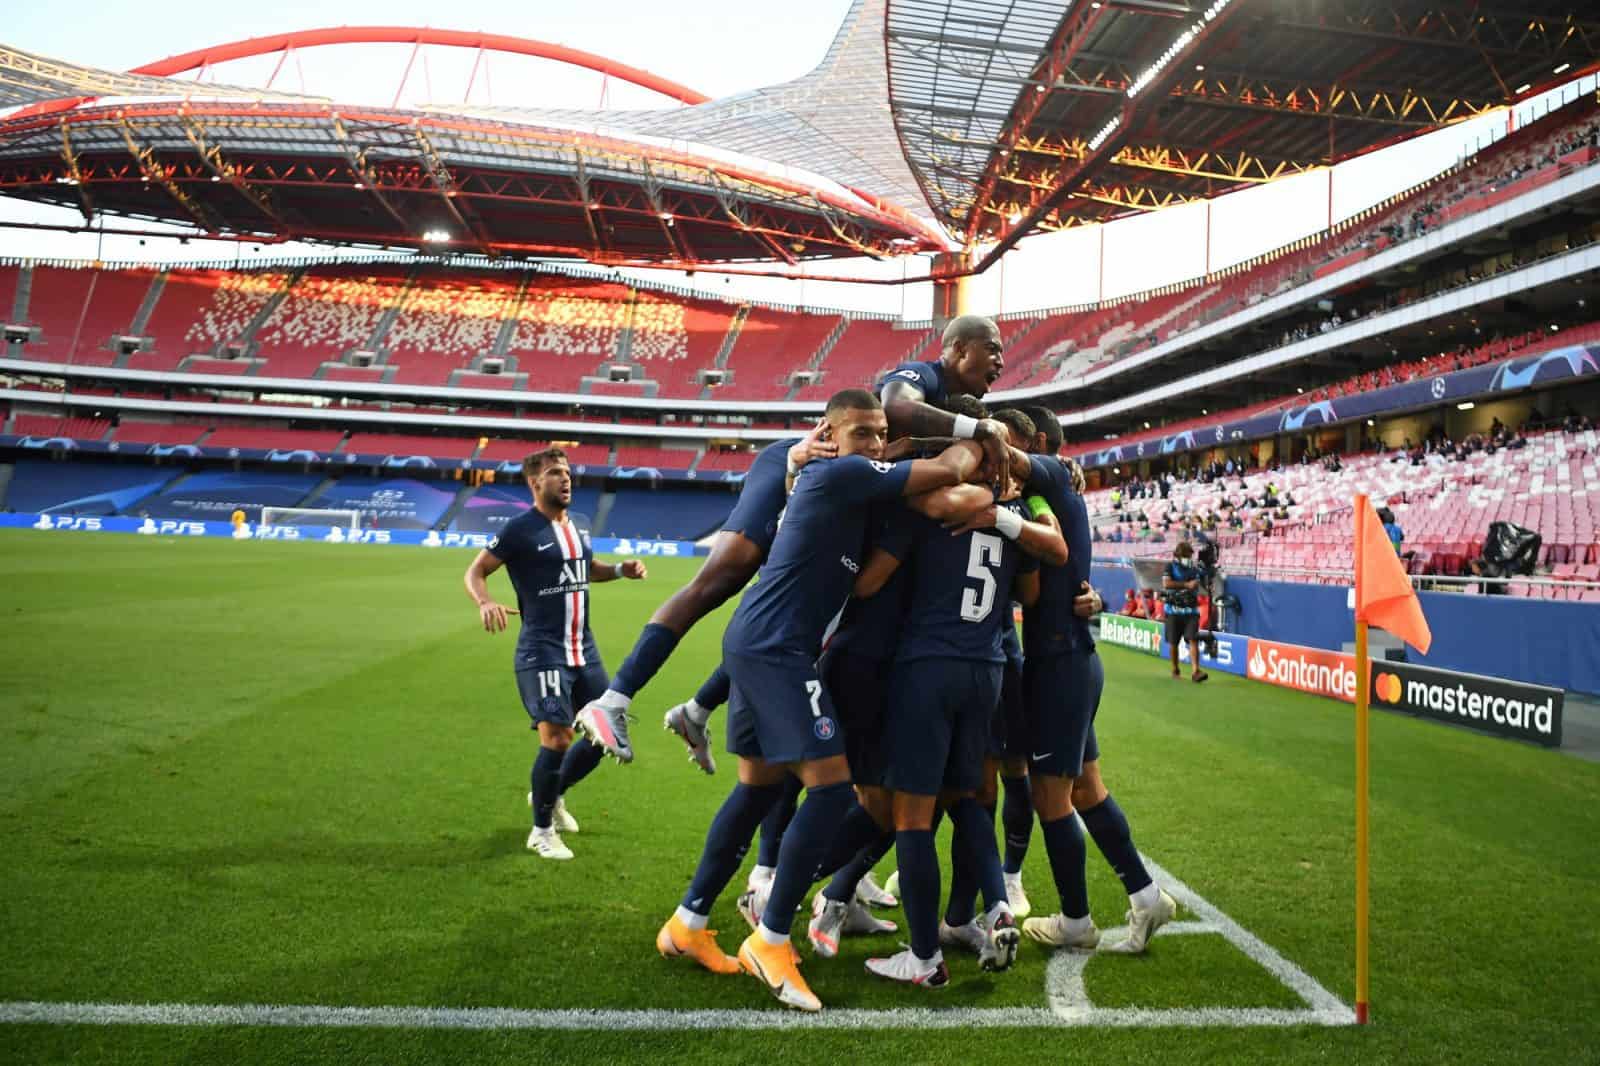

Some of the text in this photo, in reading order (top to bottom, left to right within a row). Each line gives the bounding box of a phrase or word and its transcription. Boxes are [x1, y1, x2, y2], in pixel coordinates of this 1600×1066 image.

[56, 517, 102, 530] PS5
[160, 521, 206, 534] PS5
[347, 529, 391, 543] PS5
[444, 533, 488, 546] PS5
[635, 541, 678, 555] PS5
[961, 531, 1004, 622] 5
[1100, 616, 1151, 649] Heineken
[538, 670, 561, 698] 14
[1267, 648, 1358, 698] Santande
[806, 680, 822, 717] 7
[1407, 680, 1553, 734] mastercard
